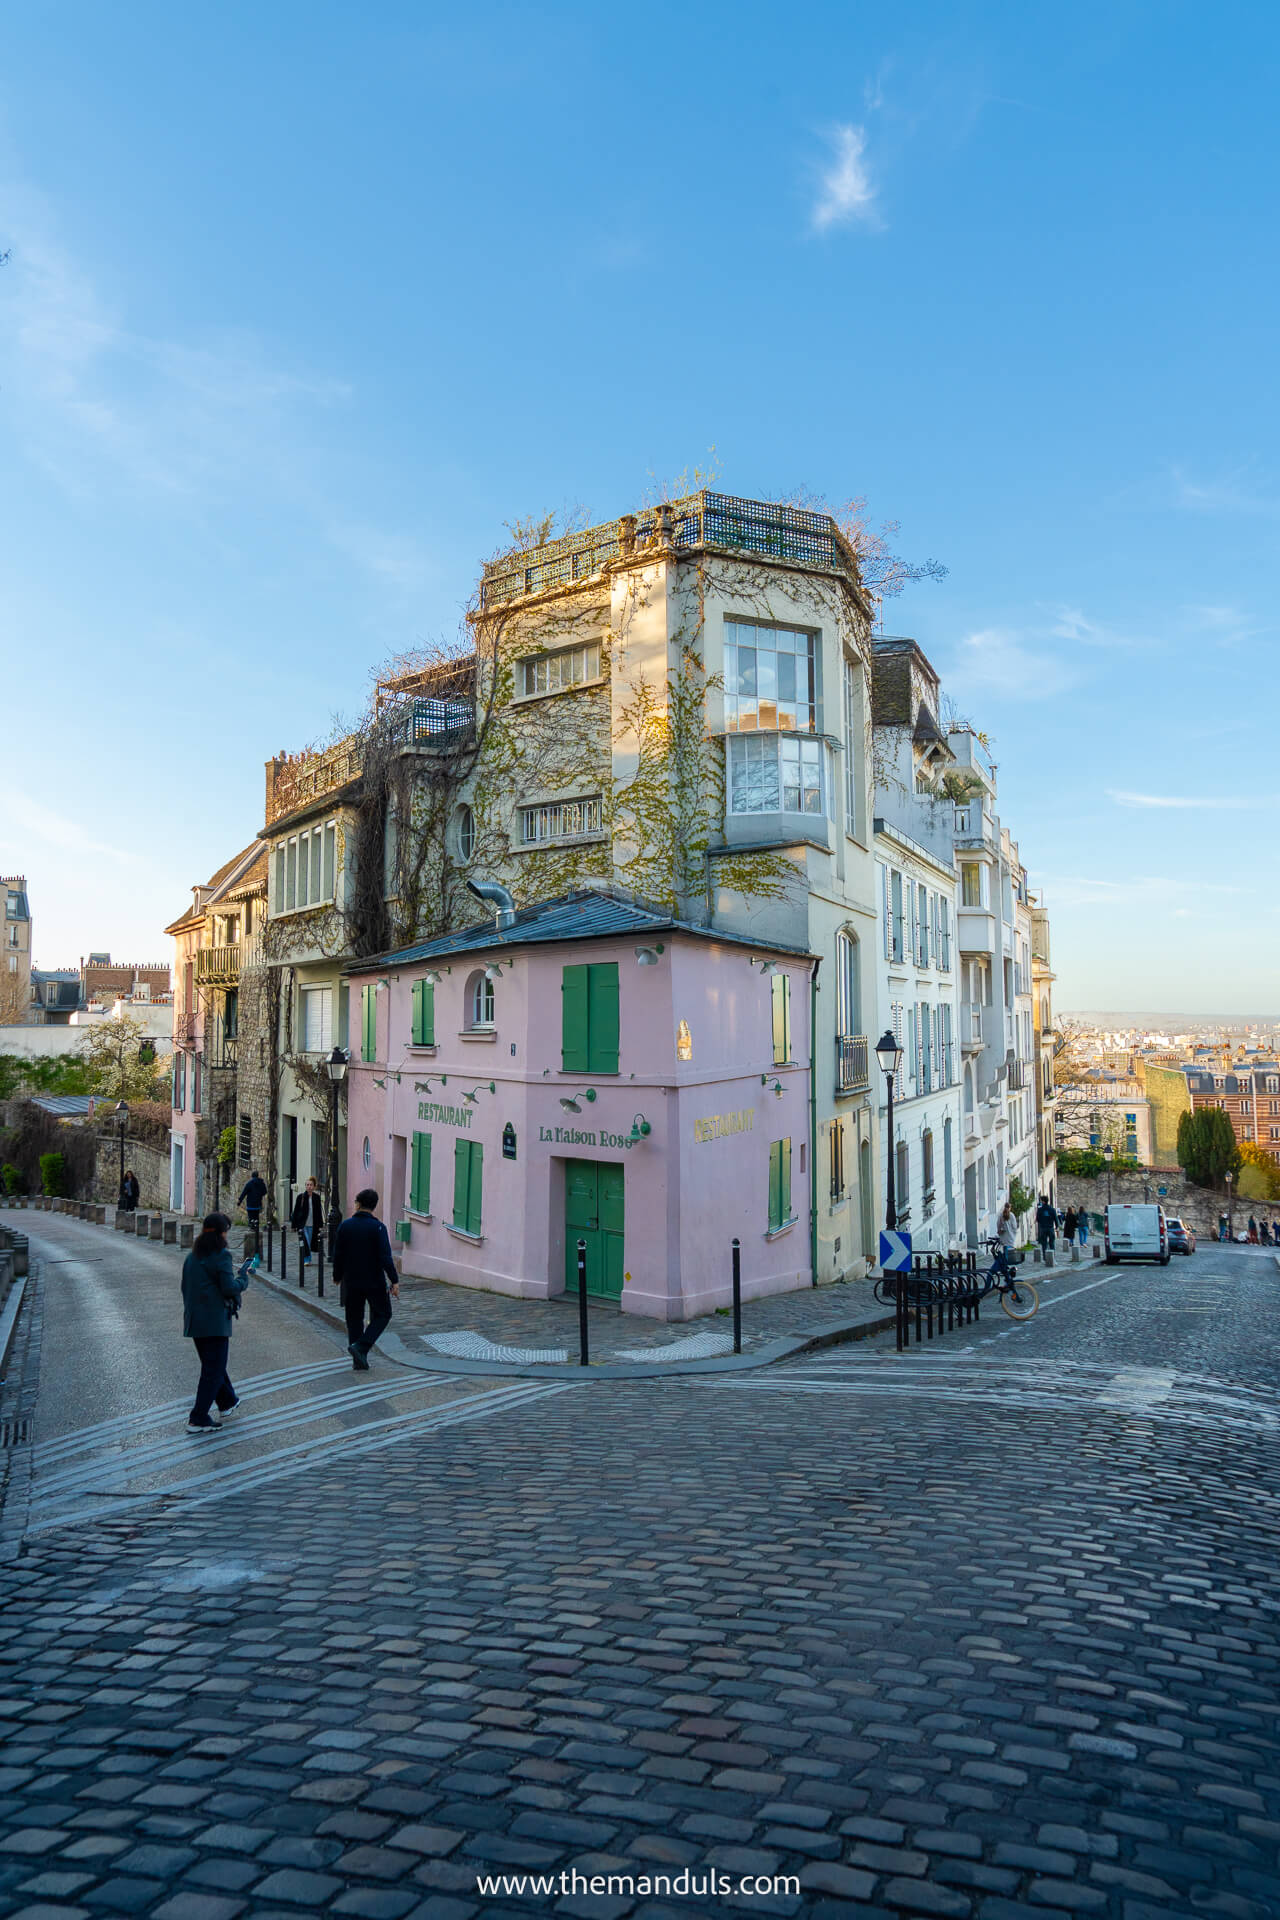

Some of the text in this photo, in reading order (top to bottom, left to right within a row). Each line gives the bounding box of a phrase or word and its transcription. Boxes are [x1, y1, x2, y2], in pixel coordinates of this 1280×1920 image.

[418, 1101, 473, 1129] RESTAURANT
[694, 1107, 755, 1144] RESTAURANT
[539, 1126, 553, 1142] La
[554, 1127, 597, 1146] Maison
